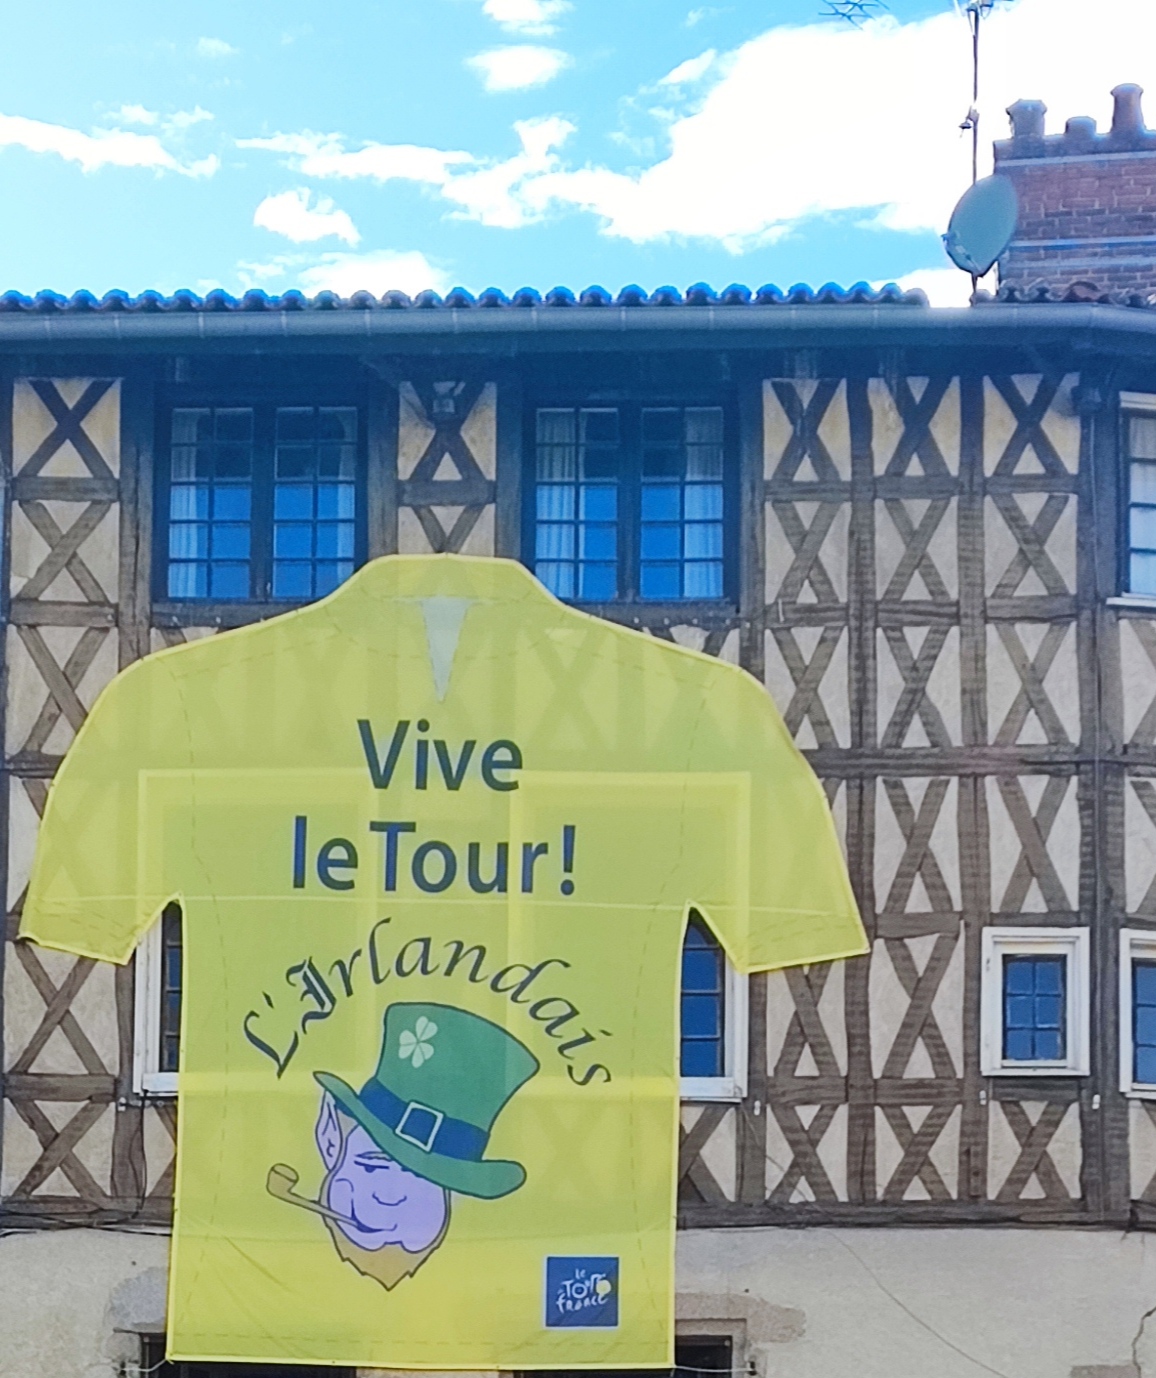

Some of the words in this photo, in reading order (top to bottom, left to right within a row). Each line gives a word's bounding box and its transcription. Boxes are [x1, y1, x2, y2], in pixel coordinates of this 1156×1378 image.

[357, 718, 524, 793] Vive
[293, 815, 359, 892] le
[369, 820, 577, 897] Tour!
[243, 916, 613, 1087] L'Irlandais
